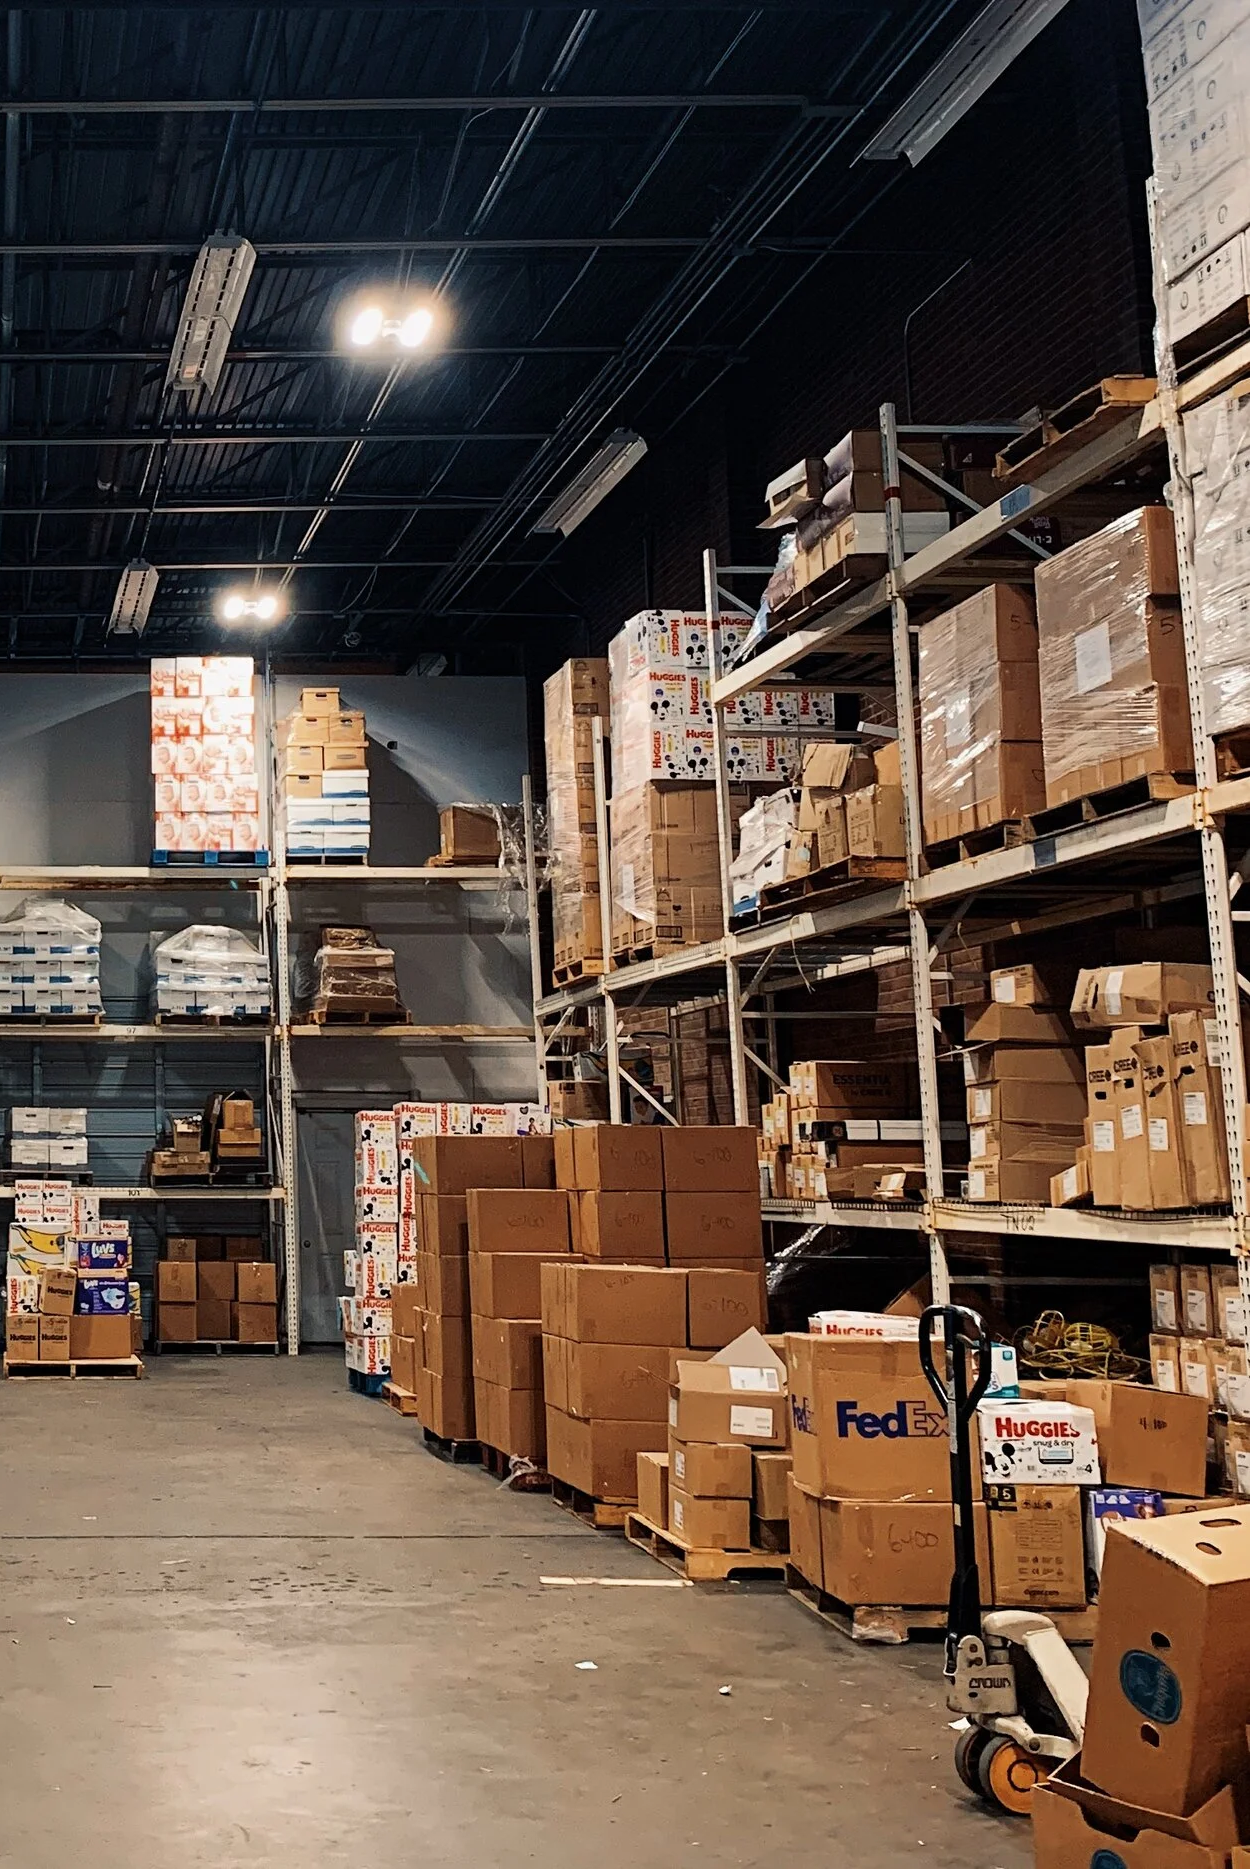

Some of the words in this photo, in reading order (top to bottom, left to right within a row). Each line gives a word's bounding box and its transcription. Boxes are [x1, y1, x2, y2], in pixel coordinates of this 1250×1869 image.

[670, 619, 680, 657] HUGGIES
[650, 672, 686, 681] HUGGIES
[690, 677, 699, 714] HUGGIES
[652, 730, 661, 768] HUGGIES
[401, 1104, 436, 1114] HUGGIES
[473, 1106, 507, 1115] HUGGIES
[360, 1113, 395, 1122] HUGGIES
[440, 1102, 448, 1133] UGGIES
[367, 1147, 375, 1185] HUGGIES
[363, 1186, 397, 1196] HUGGIES
[404, 1175, 413, 1214] HUGGIES
[363, 1224, 397, 1233] HUGGIES
[366, 1259, 375, 1299] HUGGIES
[10, 1278, 18, 1313] HUGGIES
[47, 1286, 73, 1296] HUGGIES
[363, 1300, 392, 1309] HUGGIE
[10, 1333, 36, 1341] HUGGIES
[41, 1333, 68, 1341] HUGGIES
[368, 1336, 376, 1374] HUGGIES
[836, 1400, 950, 1439] FedEx
[995, 1417, 1081, 1438] HUGGIES
[1032, 1440, 1052, 1448] snug
[1061, 1440, 1075, 1448] dry
[1085, 1464, 1092, 1473] 4
[969, 1677, 1011, 1689] CROWN
